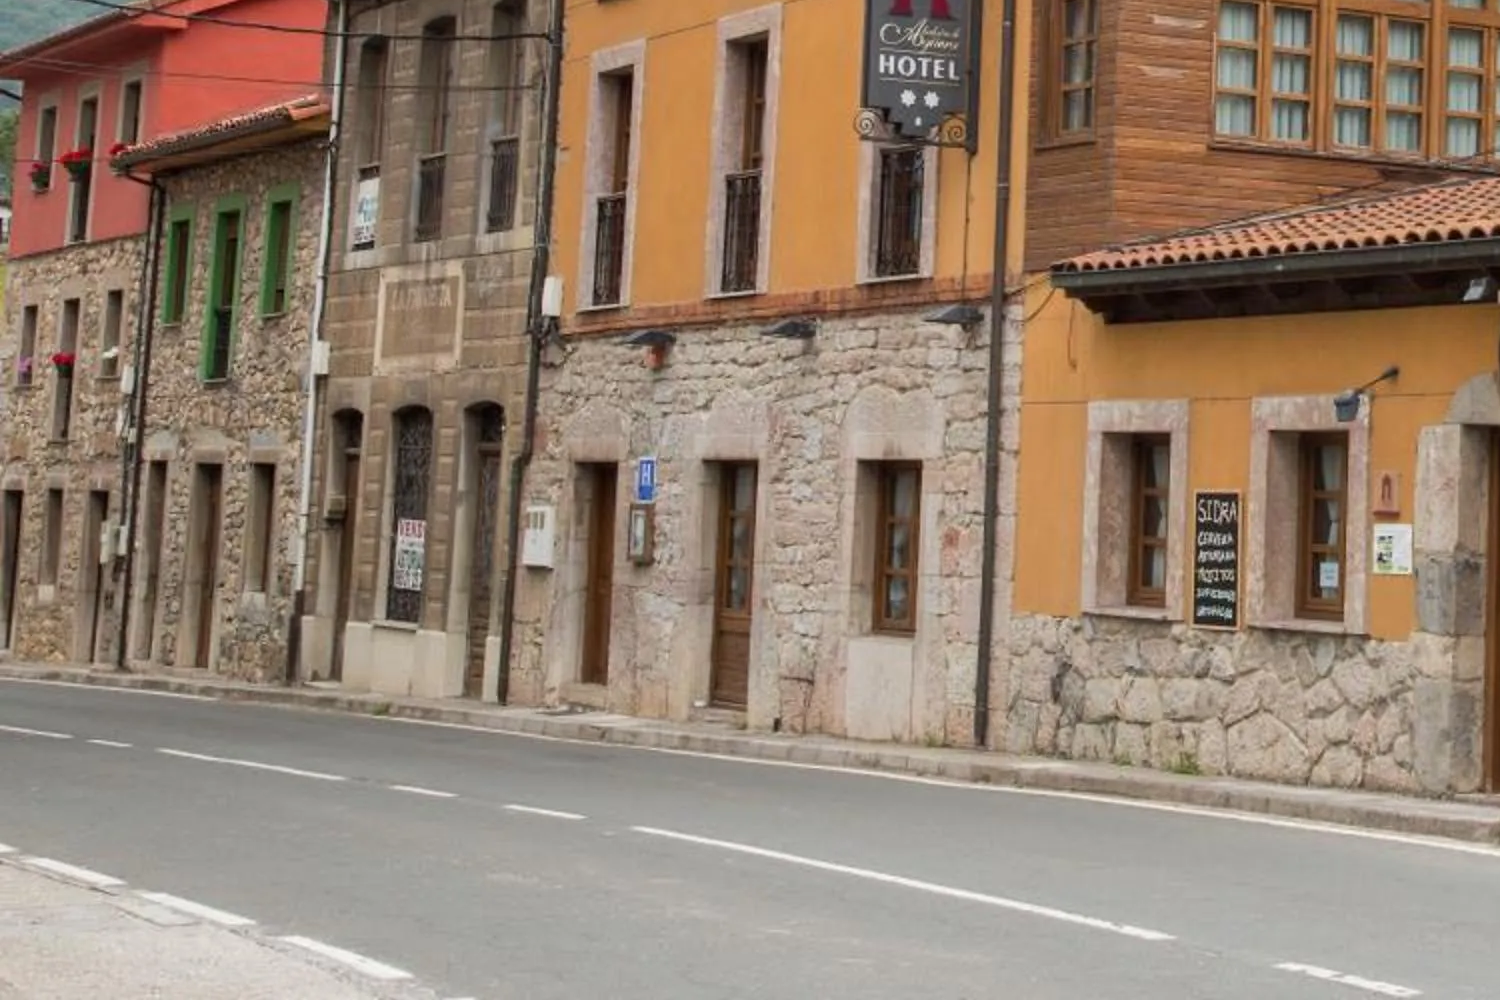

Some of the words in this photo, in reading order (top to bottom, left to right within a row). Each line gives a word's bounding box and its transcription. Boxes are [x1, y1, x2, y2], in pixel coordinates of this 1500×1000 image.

[879, 53, 960, 80] HOTEL
[641, 463, 651, 487] H
[1198, 499, 1236, 525] SIDRA
